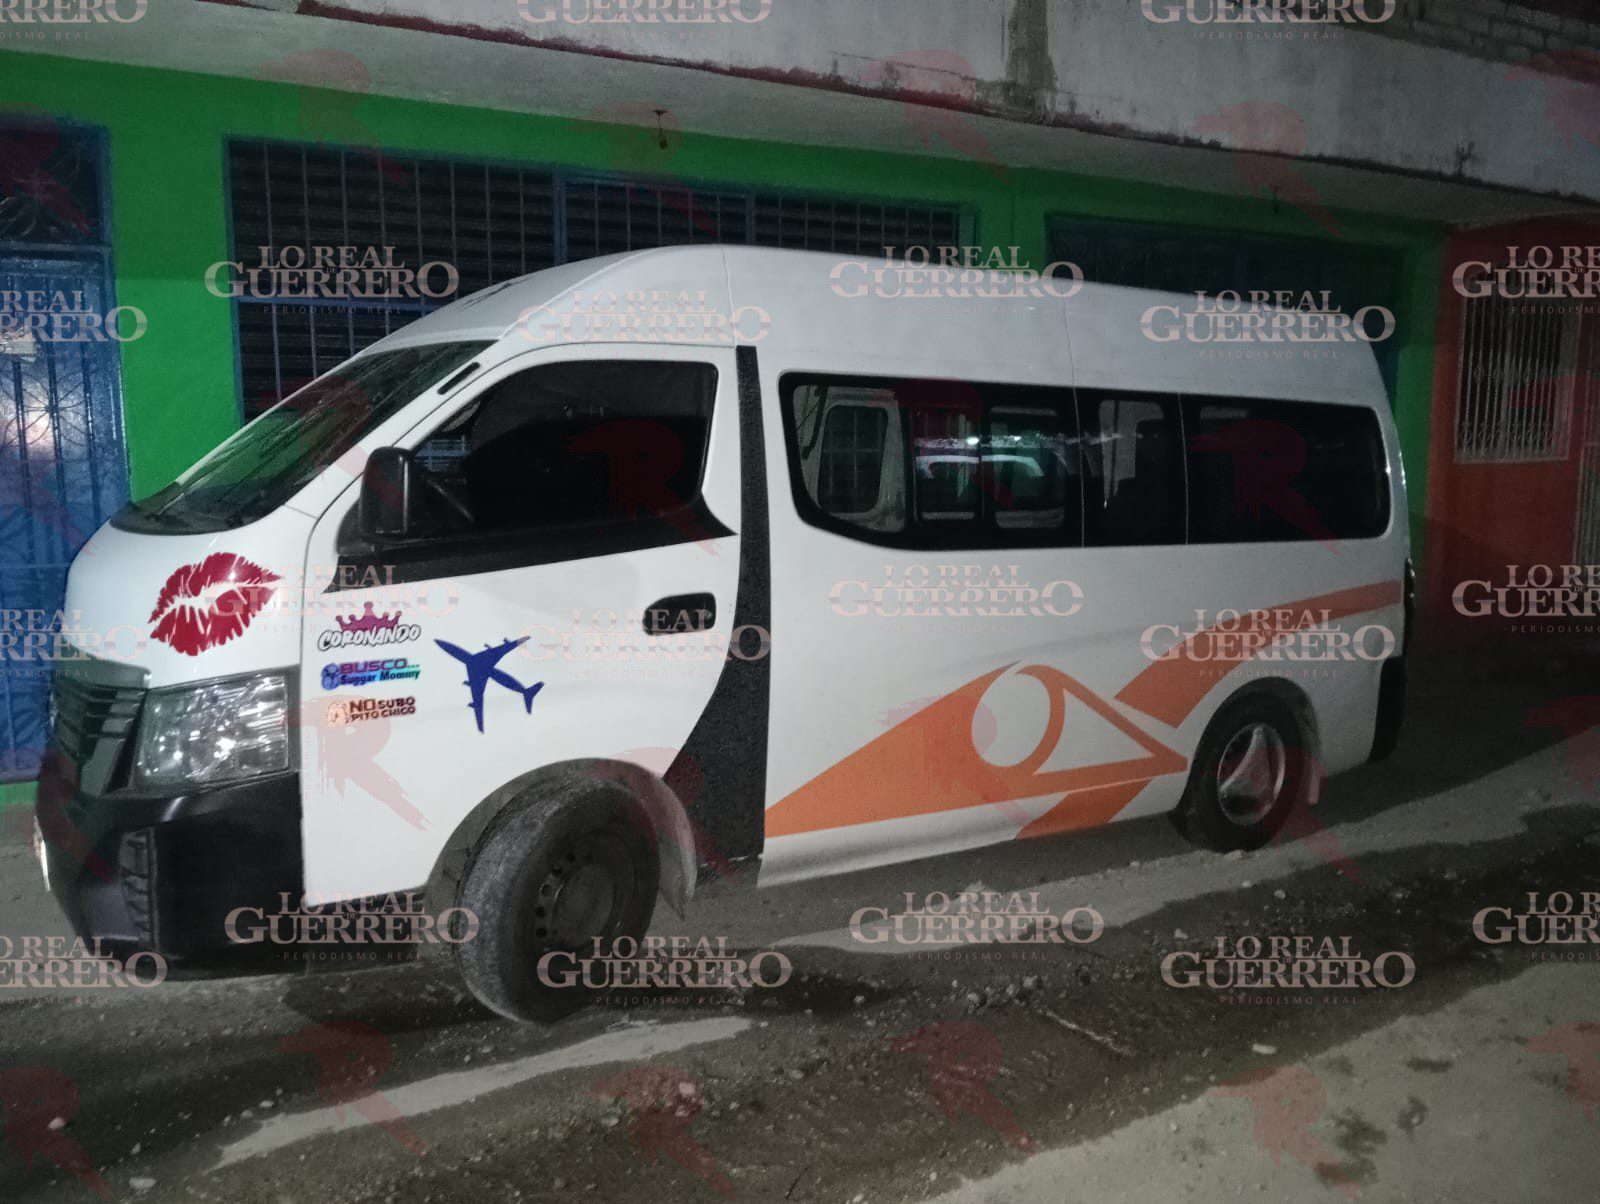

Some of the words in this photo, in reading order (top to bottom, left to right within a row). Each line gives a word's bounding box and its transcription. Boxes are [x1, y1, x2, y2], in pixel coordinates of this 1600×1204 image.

[318, 624, 421, 651] CORONANDO
[380, 670, 420, 681] Mommy
[350, 699, 376, 713] NO
[378, 696, 415, 709] SUBO
[350, 710, 379, 722] PITO
[381, 705, 416, 718] CHICO
